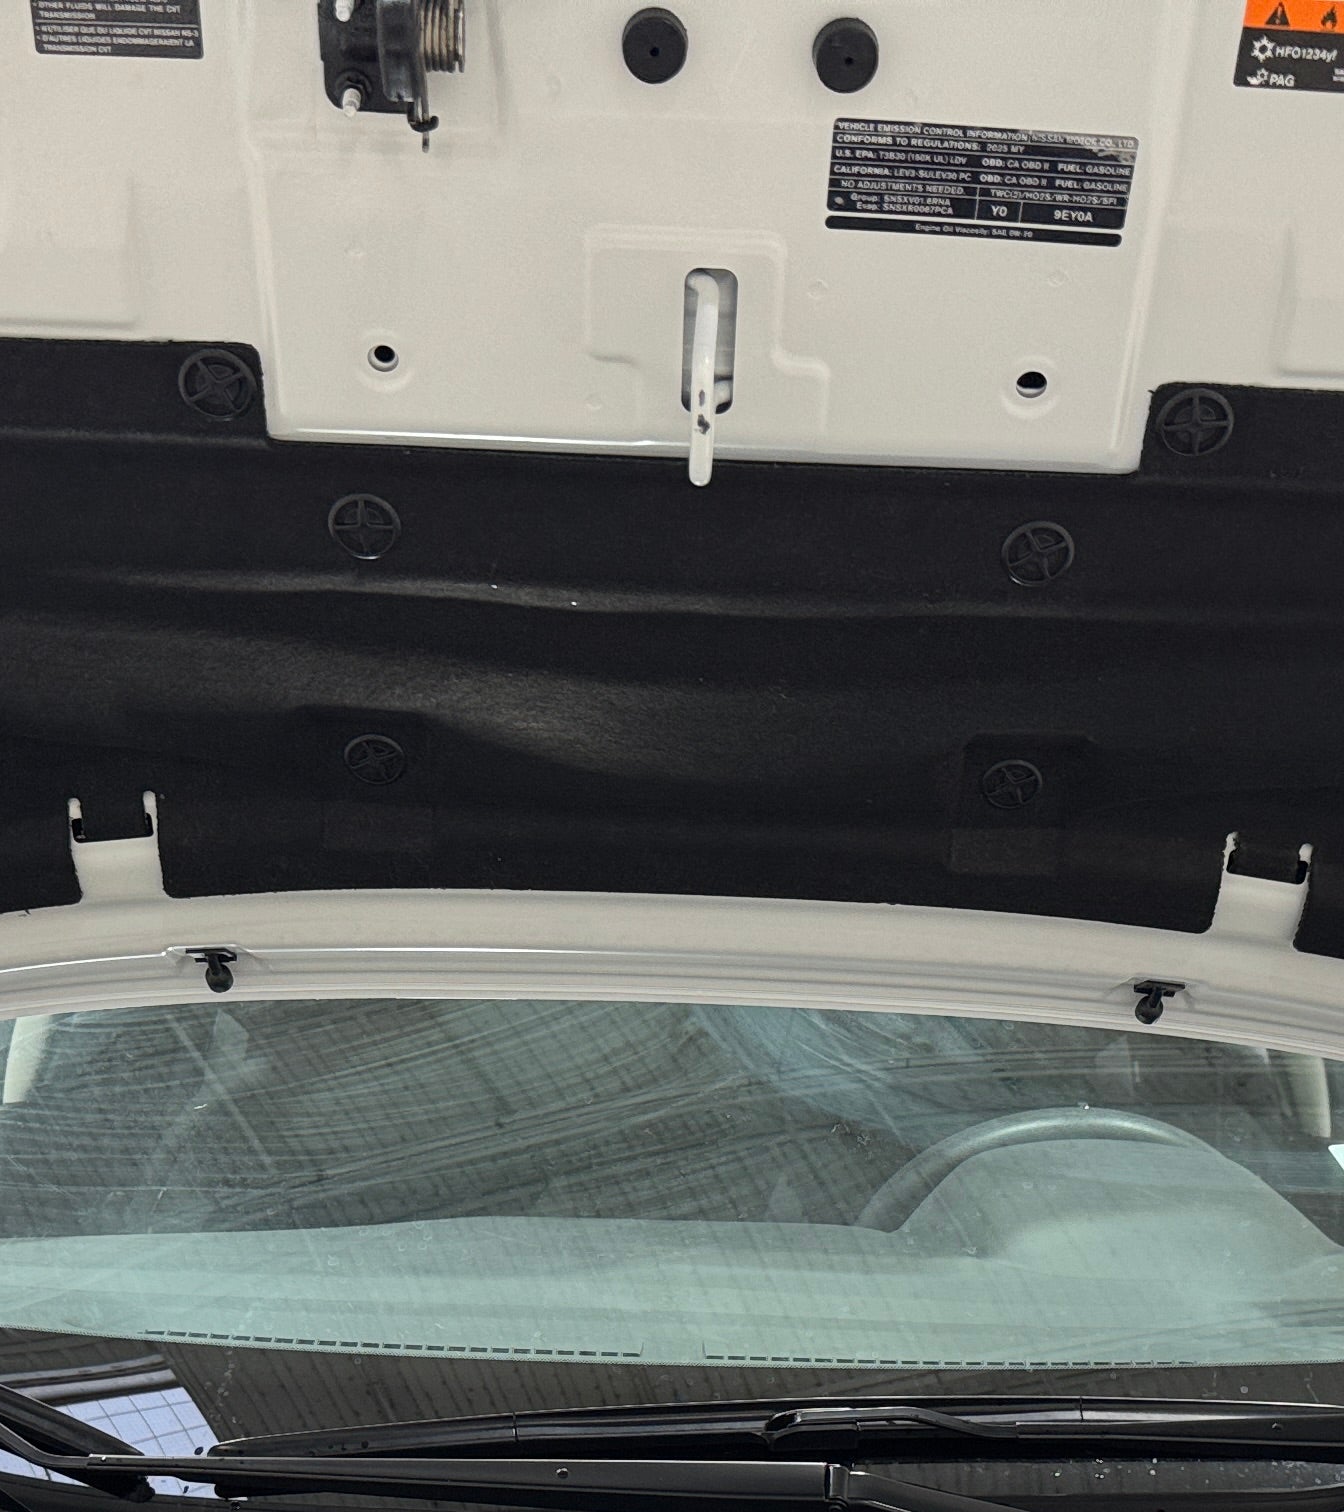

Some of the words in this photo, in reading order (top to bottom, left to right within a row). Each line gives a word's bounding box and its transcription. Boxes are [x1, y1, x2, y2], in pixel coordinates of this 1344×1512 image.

[1276, 46, 1338, 63] HFO1234yf
[1269, 73, 1295, 87] PAG
[838, 122, 875, 131] VEHICLE
[877, 123, 921, 133] EMISSION
[923, 127, 964, 137] CONTROL
[966, 130, 1028, 142] INFORMATION
[836, 134, 893, 144] CONFORMS
[896, 135, 909, 145] TO
[911, 137, 981, 151] REGULATIONS:
[835, 149, 854, 157] U.S.
[856, 150, 876, 159] EPA:
[982, 158, 1005, 167] OBD:
[1007, 159, 1020, 168] CA
[1022, 160, 1042, 169] OBD
[1057, 163, 1084, 172] FUEL:
[1086, 165, 1132, 176] GASOLINE
[959, 172, 972, 181] PC
[979, 174, 1002, 183] OBD:
[1004, 175, 1018, 184] CA
[1019, 176, 1039, 185] OBD
[1083, 181, 1129, 192] GASOLINE
[841, 180, 855, 188] NO
[857, 181, 923, 191] ADJUSTMENTS
